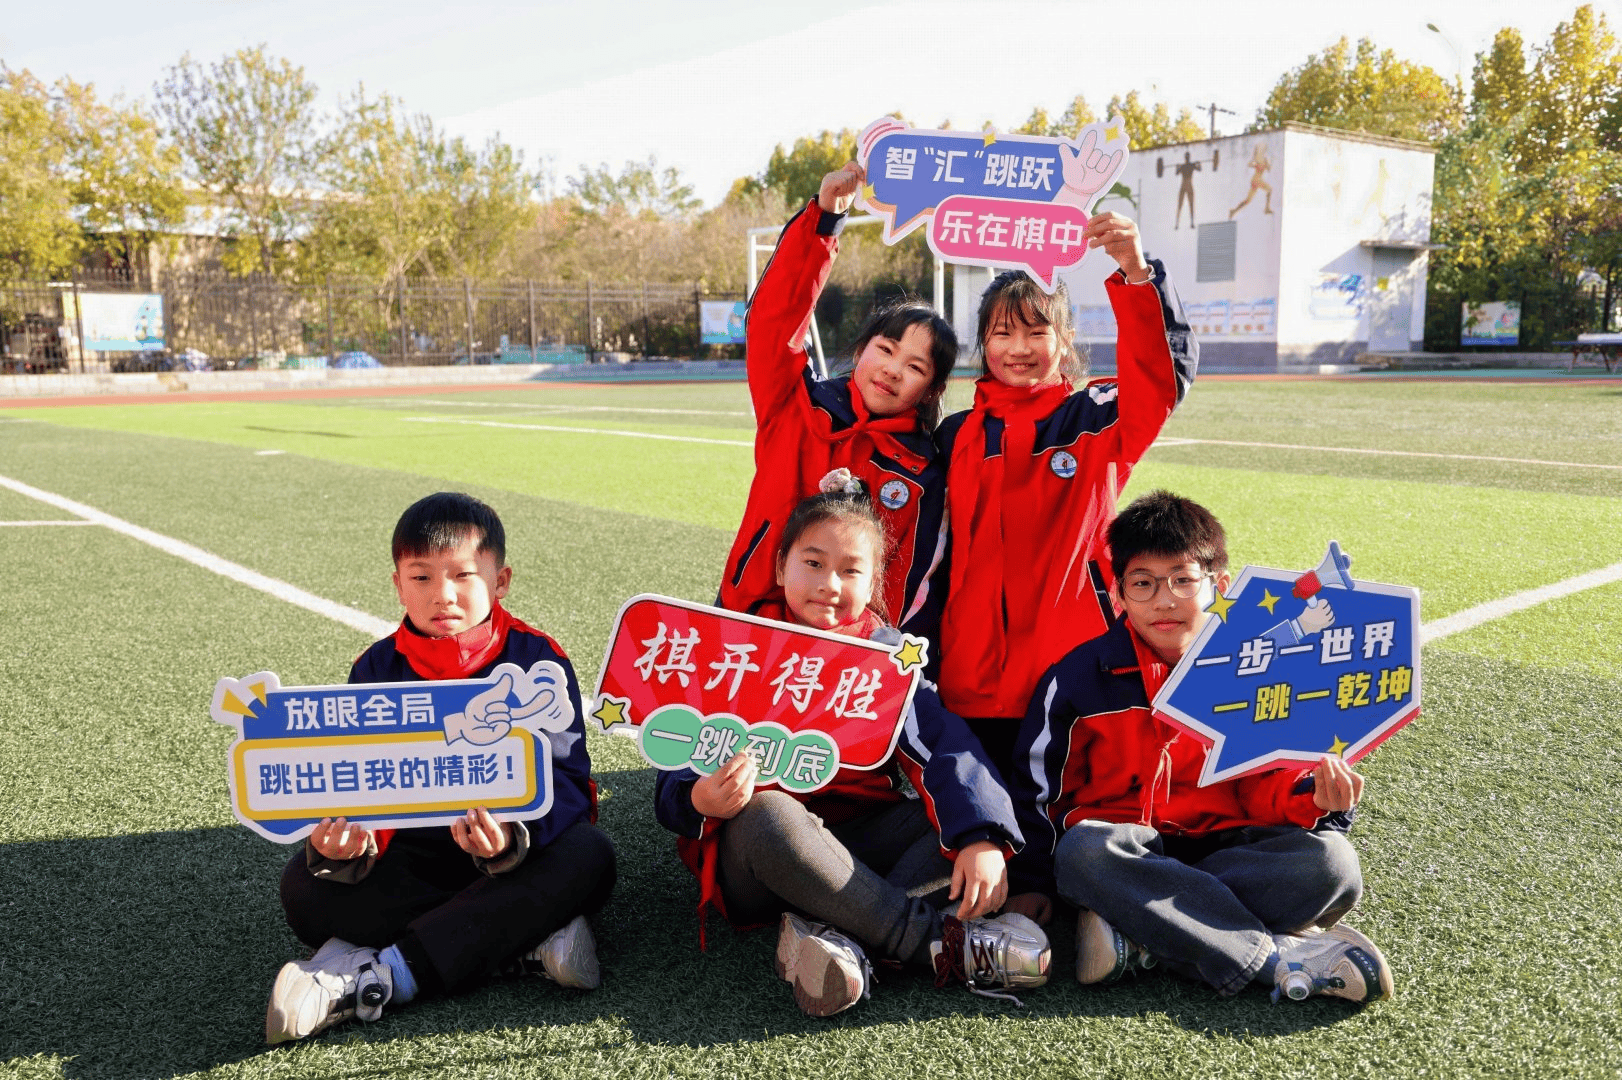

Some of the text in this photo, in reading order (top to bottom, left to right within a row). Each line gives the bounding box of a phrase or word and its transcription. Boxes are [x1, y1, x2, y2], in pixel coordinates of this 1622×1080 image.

[885, 147, 1055, 191] 智“汇”跳跃
[939, 210, 1084, 253] 乐在棋中
[633, 622, 883, 721] 棋开得胜
[1195, 620, 1396, 676] 一步一世界
[284, 692, 436, 731] 放眼全局
[1213, 666, 1413, 722] 一跳一乾坤
[259, 752, 514, 796] 跳出自我的精彩！
[650, 725, 831, 785] 一跳到底
